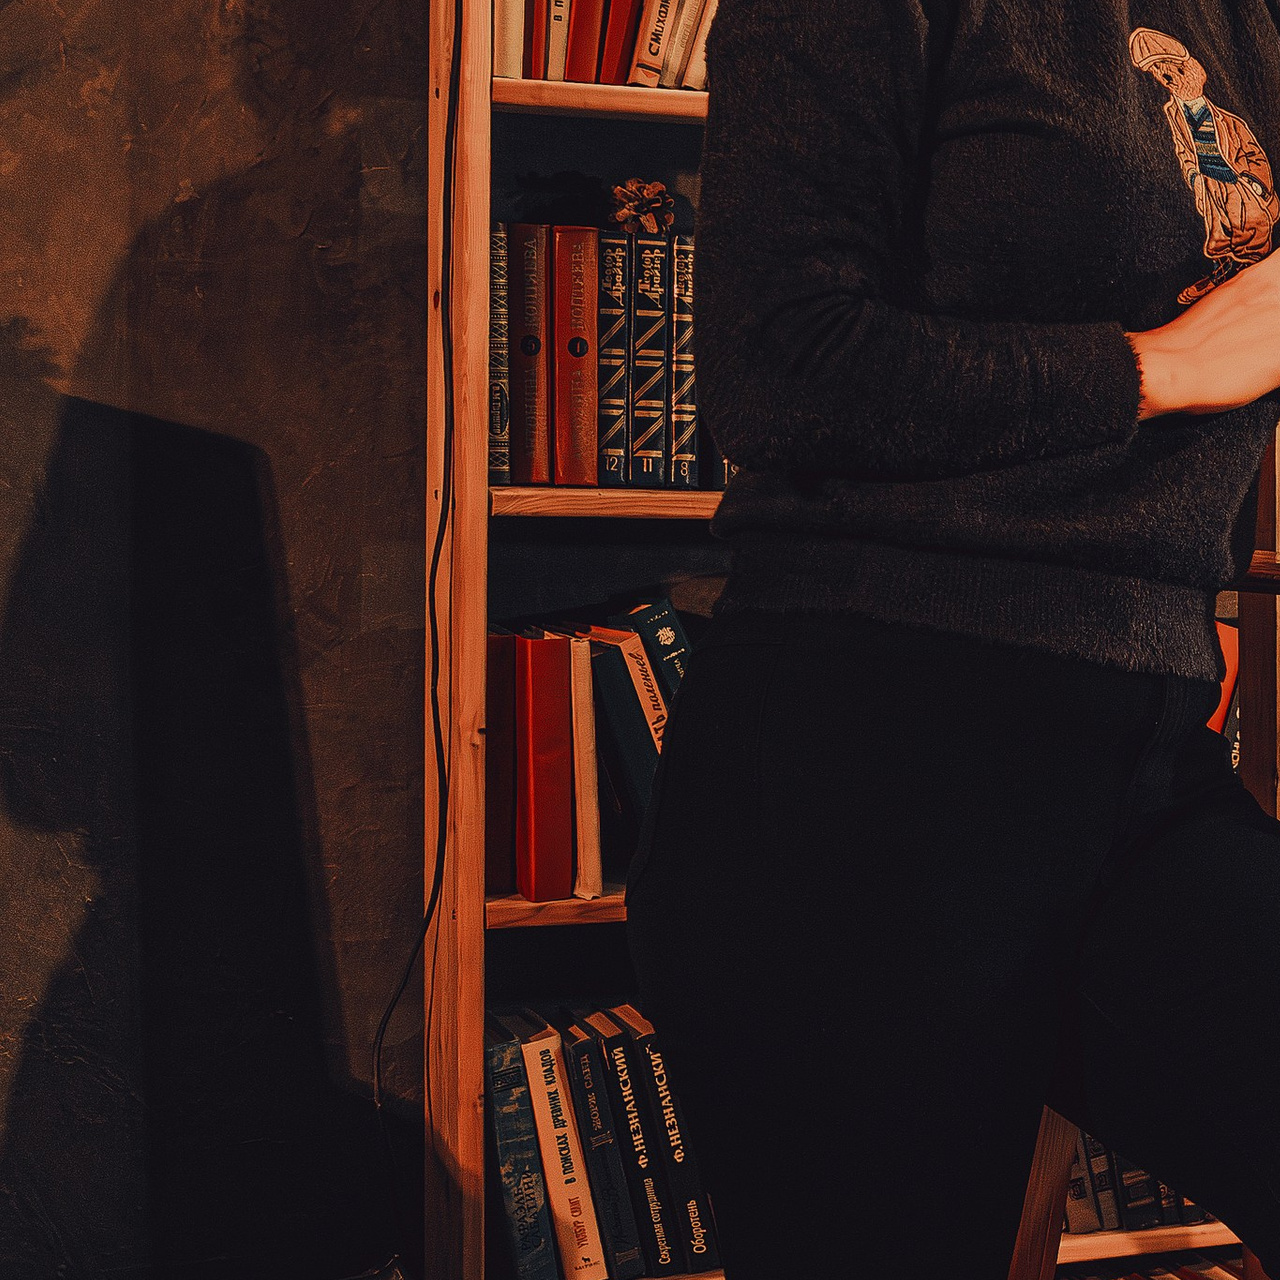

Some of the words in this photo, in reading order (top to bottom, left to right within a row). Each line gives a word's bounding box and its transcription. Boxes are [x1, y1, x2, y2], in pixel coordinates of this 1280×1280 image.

[604, 456, 617, 470] 12
[641, 458, 652, 472] 11
[679, 461, 688, 476] 8
[627, 650, 662, 713] поленьев
[537, 1047, 558, 1086] КЛАДОВ
[547, 1088, 565, 1130] ДРЕВНИХ
[611, 1045, 650, 1169] Ф.НЕЗНАНСКИЙ
[555, 1132, 575, 1175] ПОИСКАХ
[563, 1176, 576, 1185] В
[641, 1176, 663, 1223] сотрудница
[650, 1222, 672, 1266] Секретная
[682, 1198, 709, 1254] Оборотень
